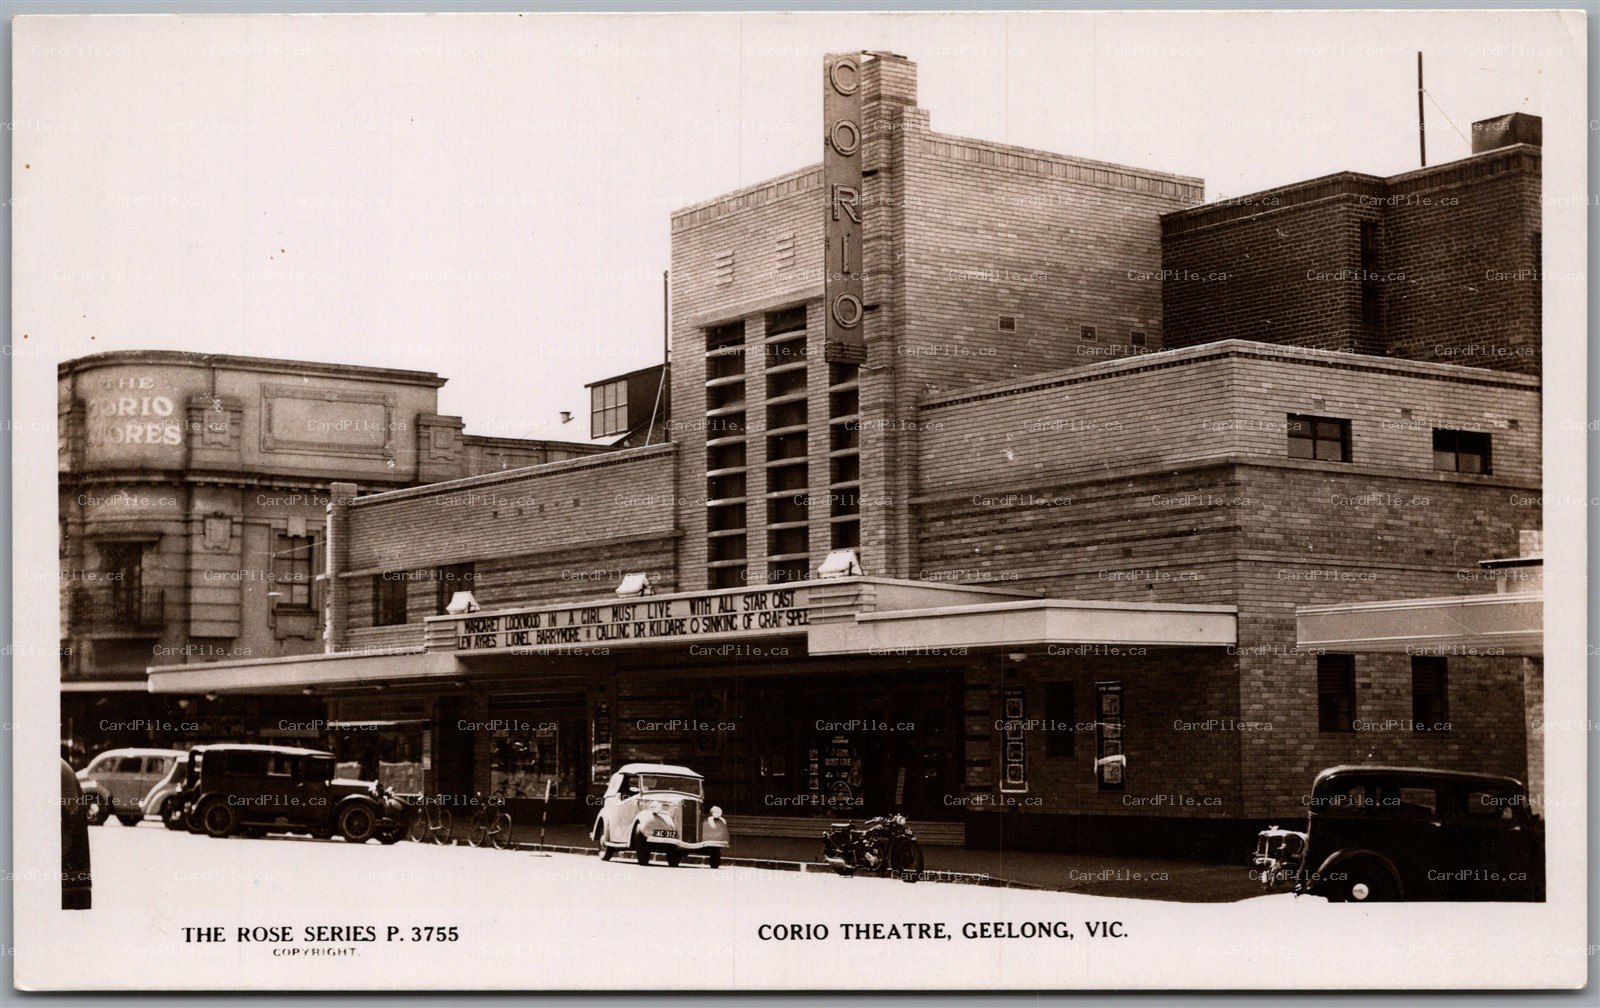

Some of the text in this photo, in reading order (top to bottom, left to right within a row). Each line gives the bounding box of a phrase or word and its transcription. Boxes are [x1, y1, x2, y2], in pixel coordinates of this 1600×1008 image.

[829, 57, 863, 328] CORIO
[457, 634, 471, 650] LEW
[474, 633, 497, 649] AYRES
[505, 630, 531, 647] LIONEL
[536, 626, 581, 645] BARRYMORE
[596, 623, 630, 641] CALLING
[634, 621, 646, 638] DR
[650, 617, 687, 637] KILDARE
[702, 613, 738, 633] SINKING
[742, 612, 755, 630] OF
[758, 609, 785, 629] GRAF
[465, 590, 796, 634] MARGARET LOCKWOOD IN A GIRL MUST LIVE WITH ALL STAR CAST
